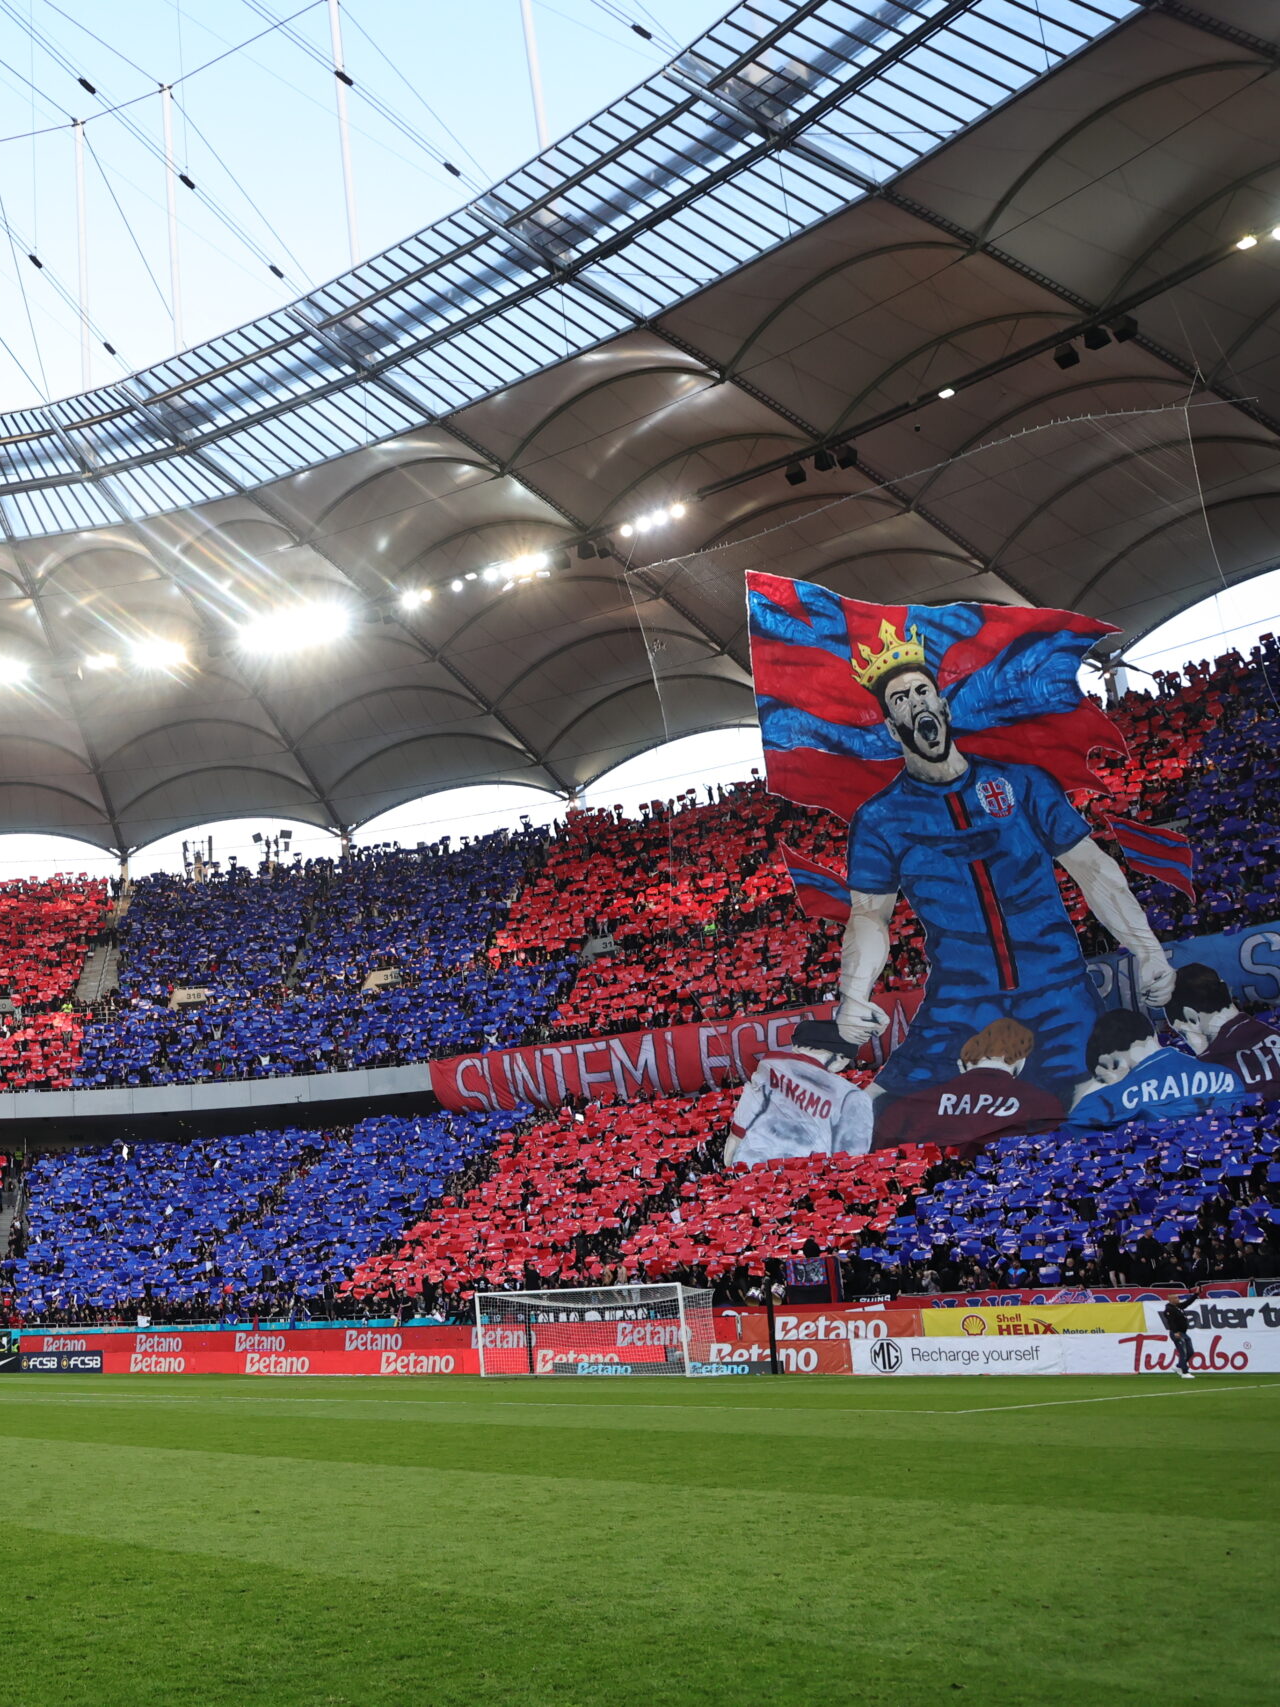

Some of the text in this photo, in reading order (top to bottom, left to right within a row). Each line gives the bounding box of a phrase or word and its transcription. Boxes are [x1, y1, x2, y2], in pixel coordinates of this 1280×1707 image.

[770, 1068, 832, 1119] DINAMO
[1122, 1070, 1235, 1109] CRAIOVA
[938, 1093, 1020, 1117] RAPID
[775, 1316, 888, 1341] Betano
[996, 1314, 1022, 1323] Shell
[997, 1320, 1058, 1336] HELIX
[43, 1337, 86, 1352] Betano
[136, 1334, 182, 1352] Betano
[235, 1332, 285, 1352] Betano
[345, 1329, 402, 1351] Betano
[471, 1327, 536, 1349] Betano
[617, 1322, 692, 1347] Betano
[29, 1357, 58, 1369] FCSB
[69, 1356, 101, 1369] FCSB
[130, 1353, 185, 1373] Betano
[380, 1351, 455, 1374] Betano
[873, 1342, 900, 1370] MG
[911, 1345, 1041, 1365] Recharge yourself
[1118, 1334, 1249, 1372] Tuabo
[245, 1353, 310, 1374] Betano
[577, 1362, 632, 1375] Betano
[689, 1362, 750, 1375] Betano
